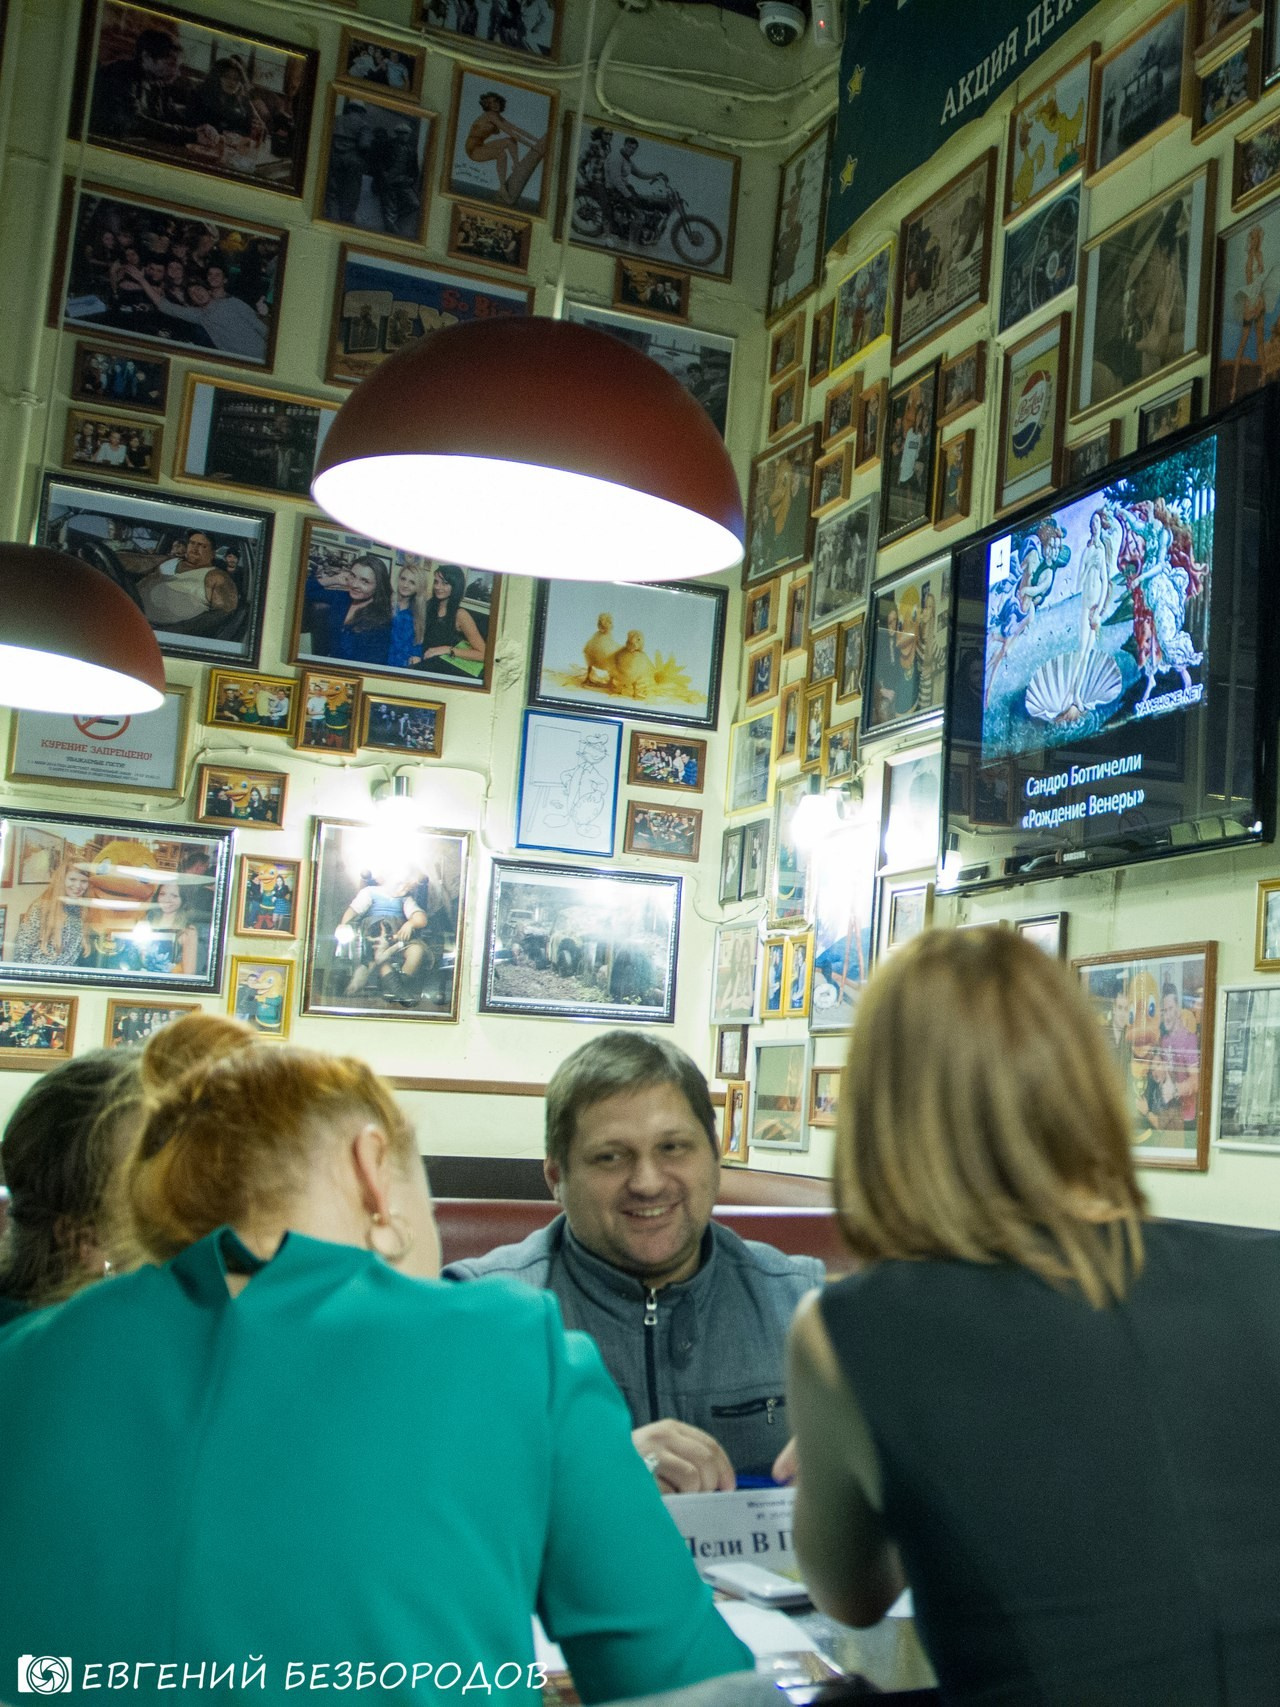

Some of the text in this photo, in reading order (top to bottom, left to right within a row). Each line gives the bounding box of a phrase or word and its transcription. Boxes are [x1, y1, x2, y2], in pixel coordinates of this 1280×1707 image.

[941, 27, 1019, 125] АКЦИЯ
[41, 739, 152, 761] КУРЕНИЕ ЗАПРЕЩЕНО!
[1026, 754, 1142, 796] Сандро Боттичелли
[1022, 789, 1145, 829] «Рождение Венеры»
[751, 1532, 770, 1554] В
